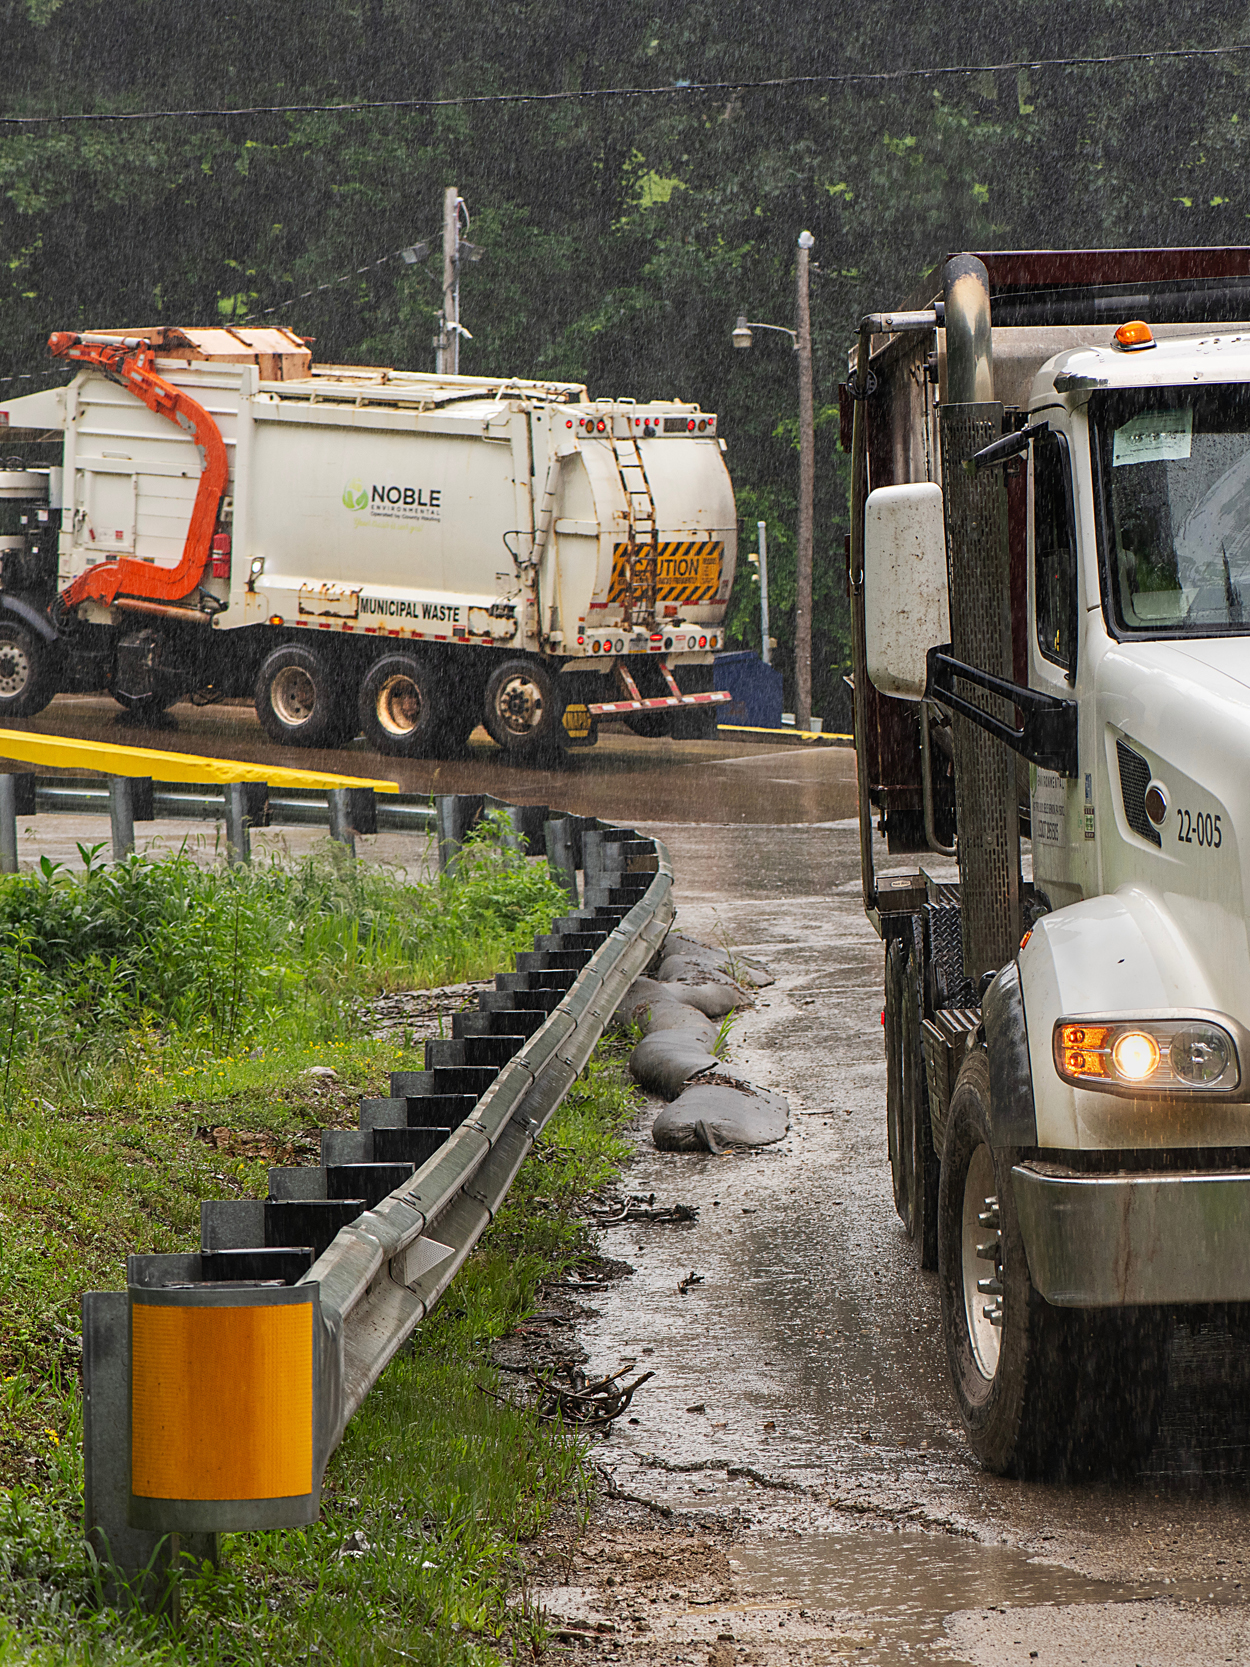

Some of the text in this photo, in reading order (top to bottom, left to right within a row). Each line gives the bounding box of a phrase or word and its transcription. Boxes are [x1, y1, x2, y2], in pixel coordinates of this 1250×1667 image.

[371, 485, 441, 507] NOBLE
[371, 504, 440, 515] ENVIRONMENTAL
[360, 598, 460, 623] MUNICIPAL WASTE
[1177, 808, 1222, 849] 22-005
